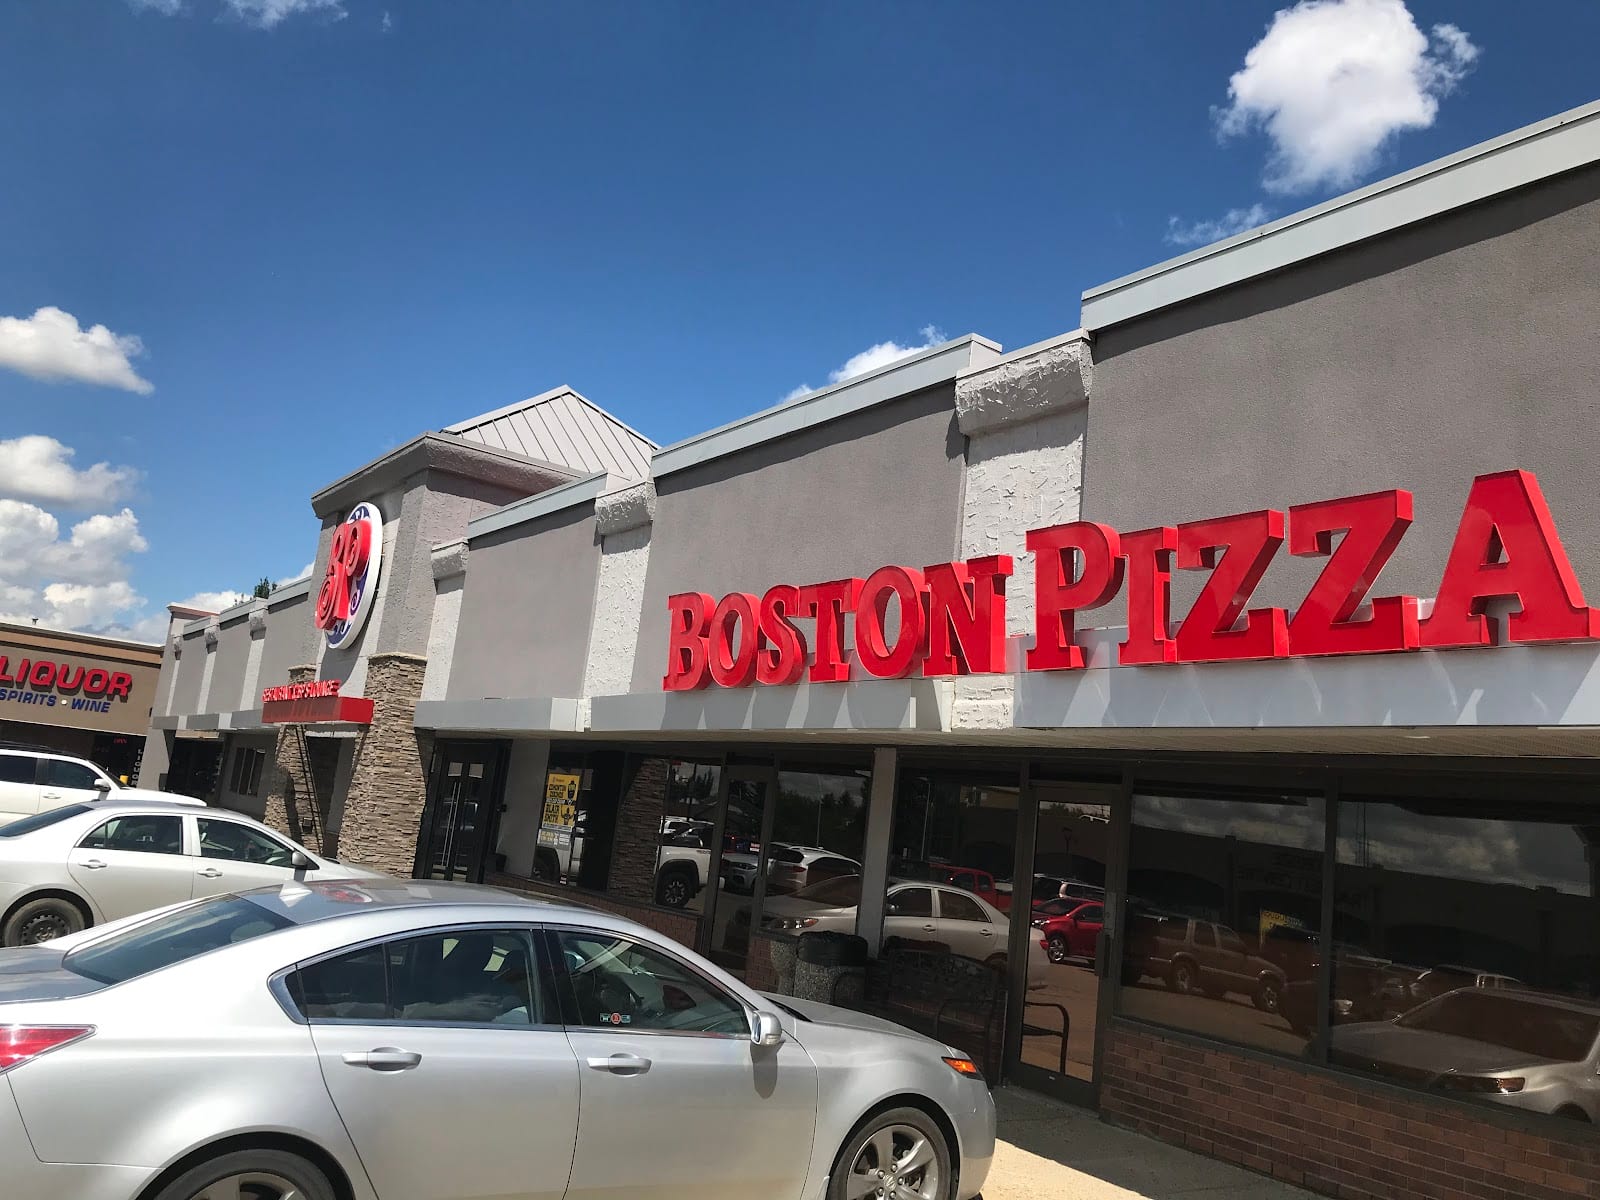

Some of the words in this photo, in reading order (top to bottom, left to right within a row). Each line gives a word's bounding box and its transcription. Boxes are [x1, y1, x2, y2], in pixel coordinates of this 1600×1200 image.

[662, 555, 1013, 692] BOSTON
[1026, 469, 1600, 671] PIZZA
[0, 656, 132, 702] LIQUOR
[0, 689, 57, 707] SPIRITS
[71, 698, 111, 713] WINE
